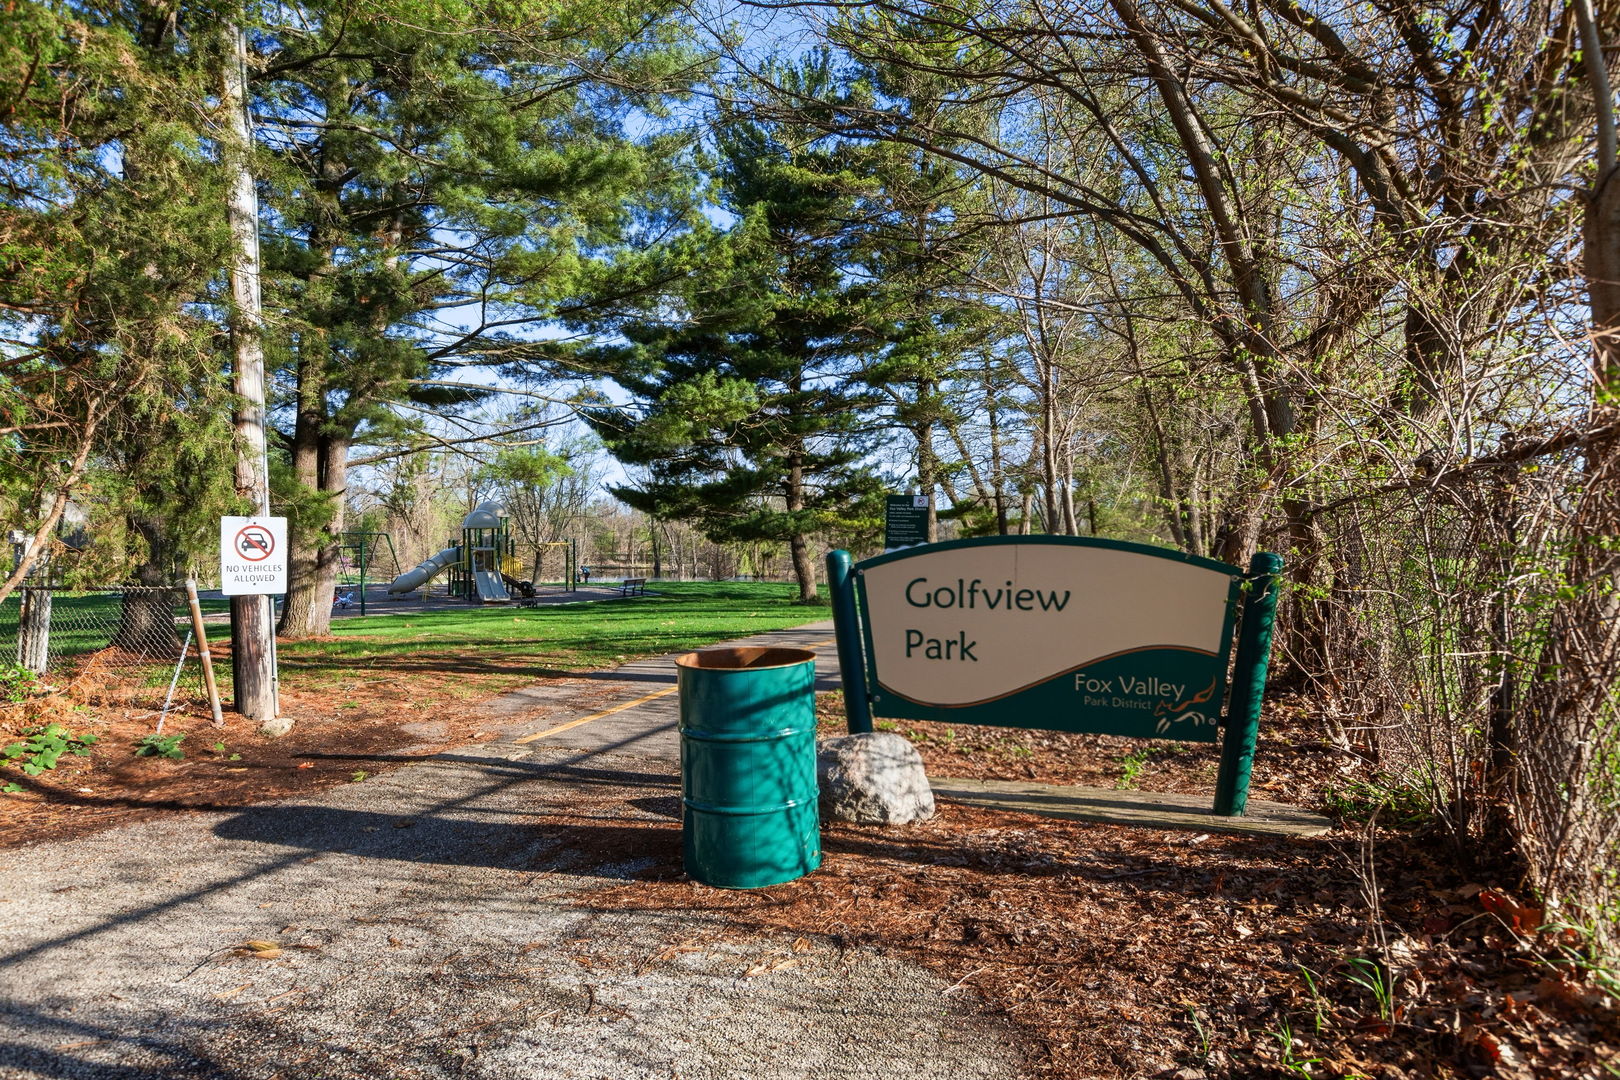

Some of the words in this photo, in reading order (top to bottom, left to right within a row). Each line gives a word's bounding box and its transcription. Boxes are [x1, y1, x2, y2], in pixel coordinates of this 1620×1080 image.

[905, 577, 1071, 612] Golfview
[905, 629, 978, 662] Park
[1075, 673, 1112, 693] Fox
[1118, 675, 1185, 702] Valley
[1084, 695, 1109, 707] Park
[1112, 697, 1152, 710] District
